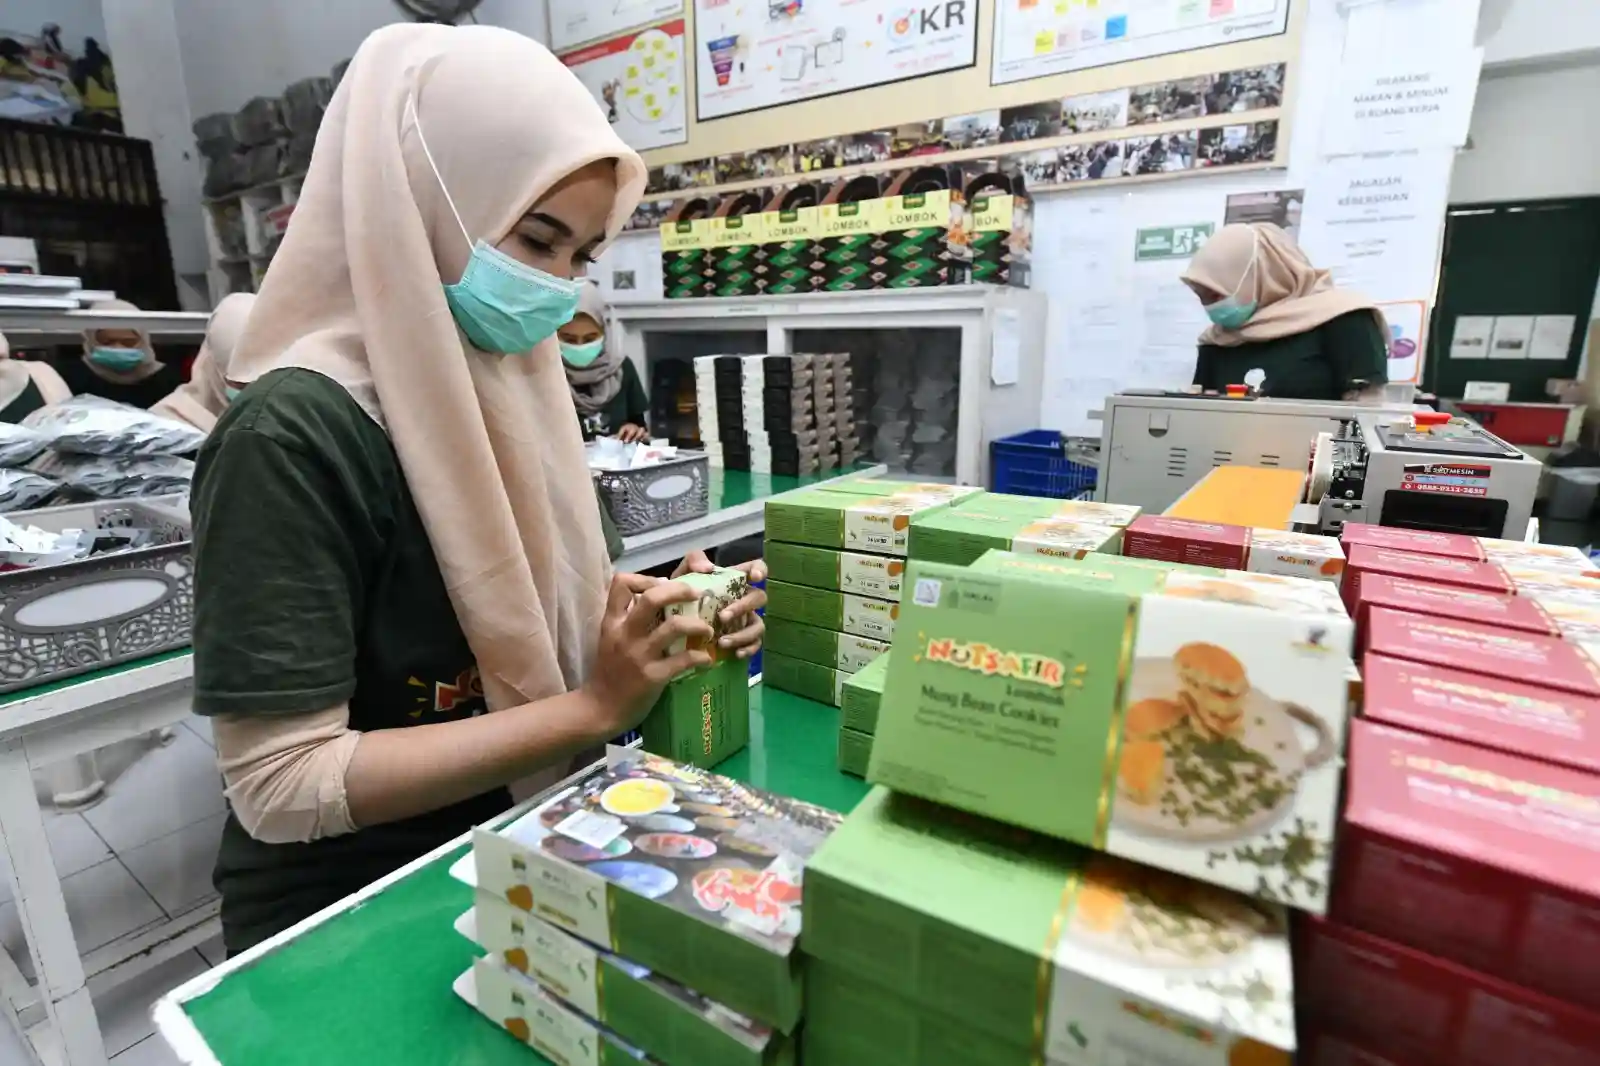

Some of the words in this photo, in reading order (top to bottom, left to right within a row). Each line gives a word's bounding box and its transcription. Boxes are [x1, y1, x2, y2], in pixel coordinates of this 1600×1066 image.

[826, 218, 870, 232] LOMBOK
[889, 211, 938, 225] LOMBOK
[715, 231, 753, 243] LOMBOK
[768, 227, 808, 238] LOMBOK
[926, 637, 1065, 688] NUTSAFIR
